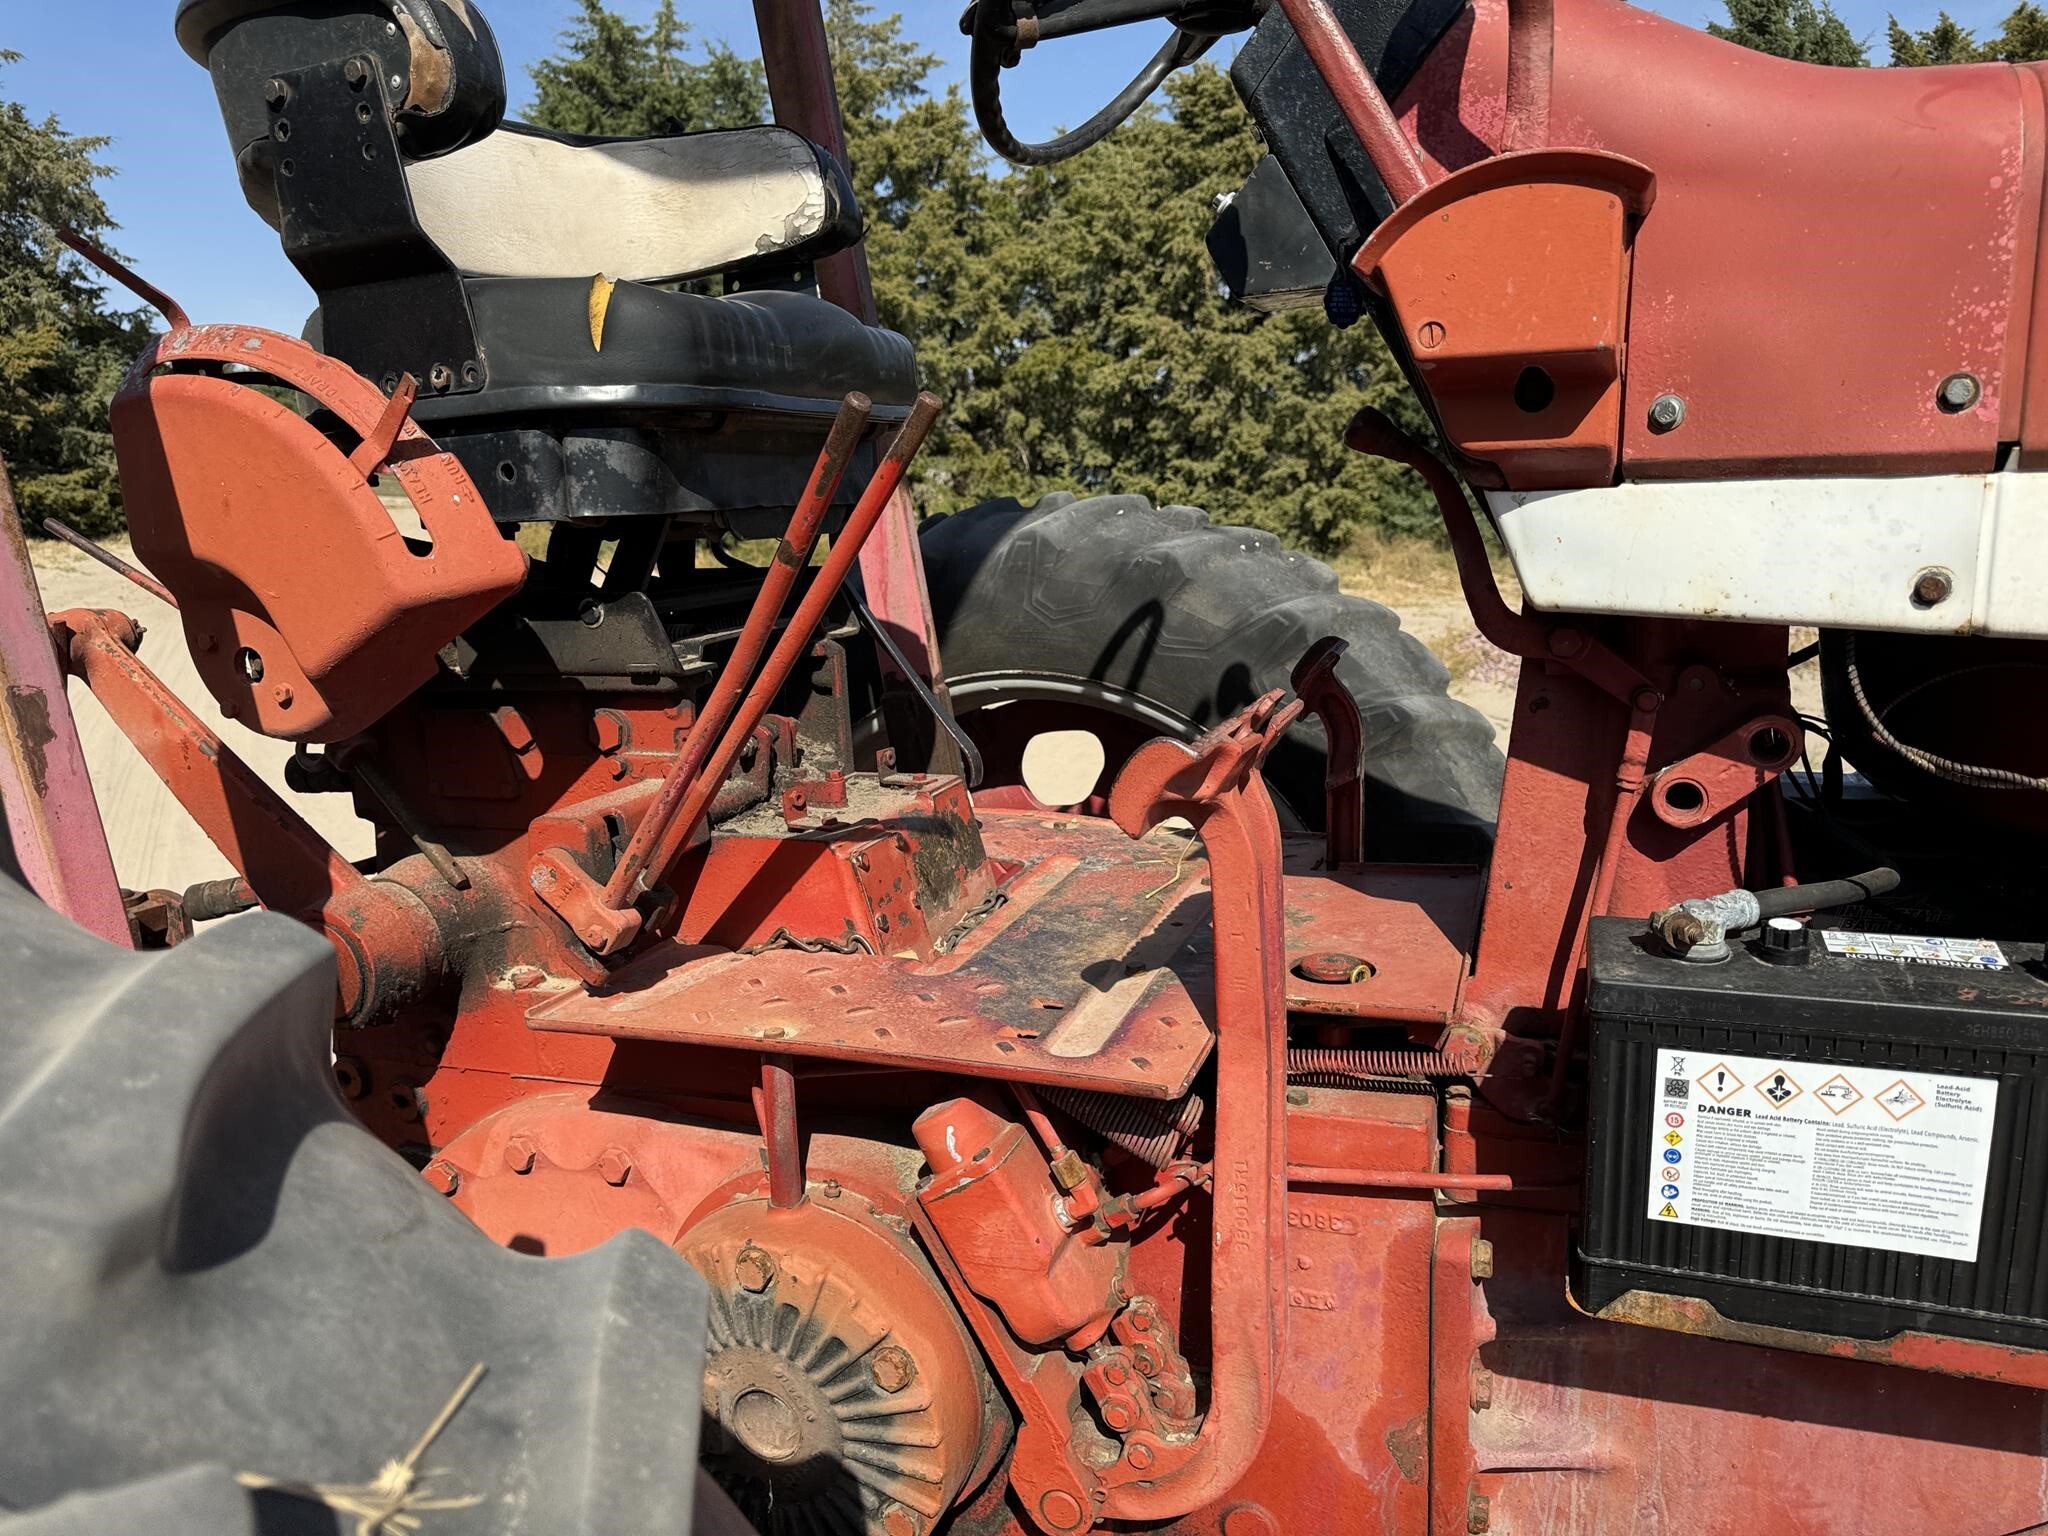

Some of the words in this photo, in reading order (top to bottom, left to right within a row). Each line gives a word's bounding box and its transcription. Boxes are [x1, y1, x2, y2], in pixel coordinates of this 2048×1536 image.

[1916, 957, 1986, 971] DANGER
[1937, 1084, 1971, 1092] Lead-Acid
[1936, 1090, 1961, 1098] Battery
[1935, 1096, 1972, 1104] Electrolyte
[1934, 1102, 1963, 1110] (Sulfuric
[1670, 1116, 1679, 1124] 15
[1697, 1104, 1752, 1118] DANGER
[1783, 1116, 1803, 1125] Battery
[1804, 1118, 1831, 1127] Contains:
[1846, 1122, 1865, 1131] Sulfuric
